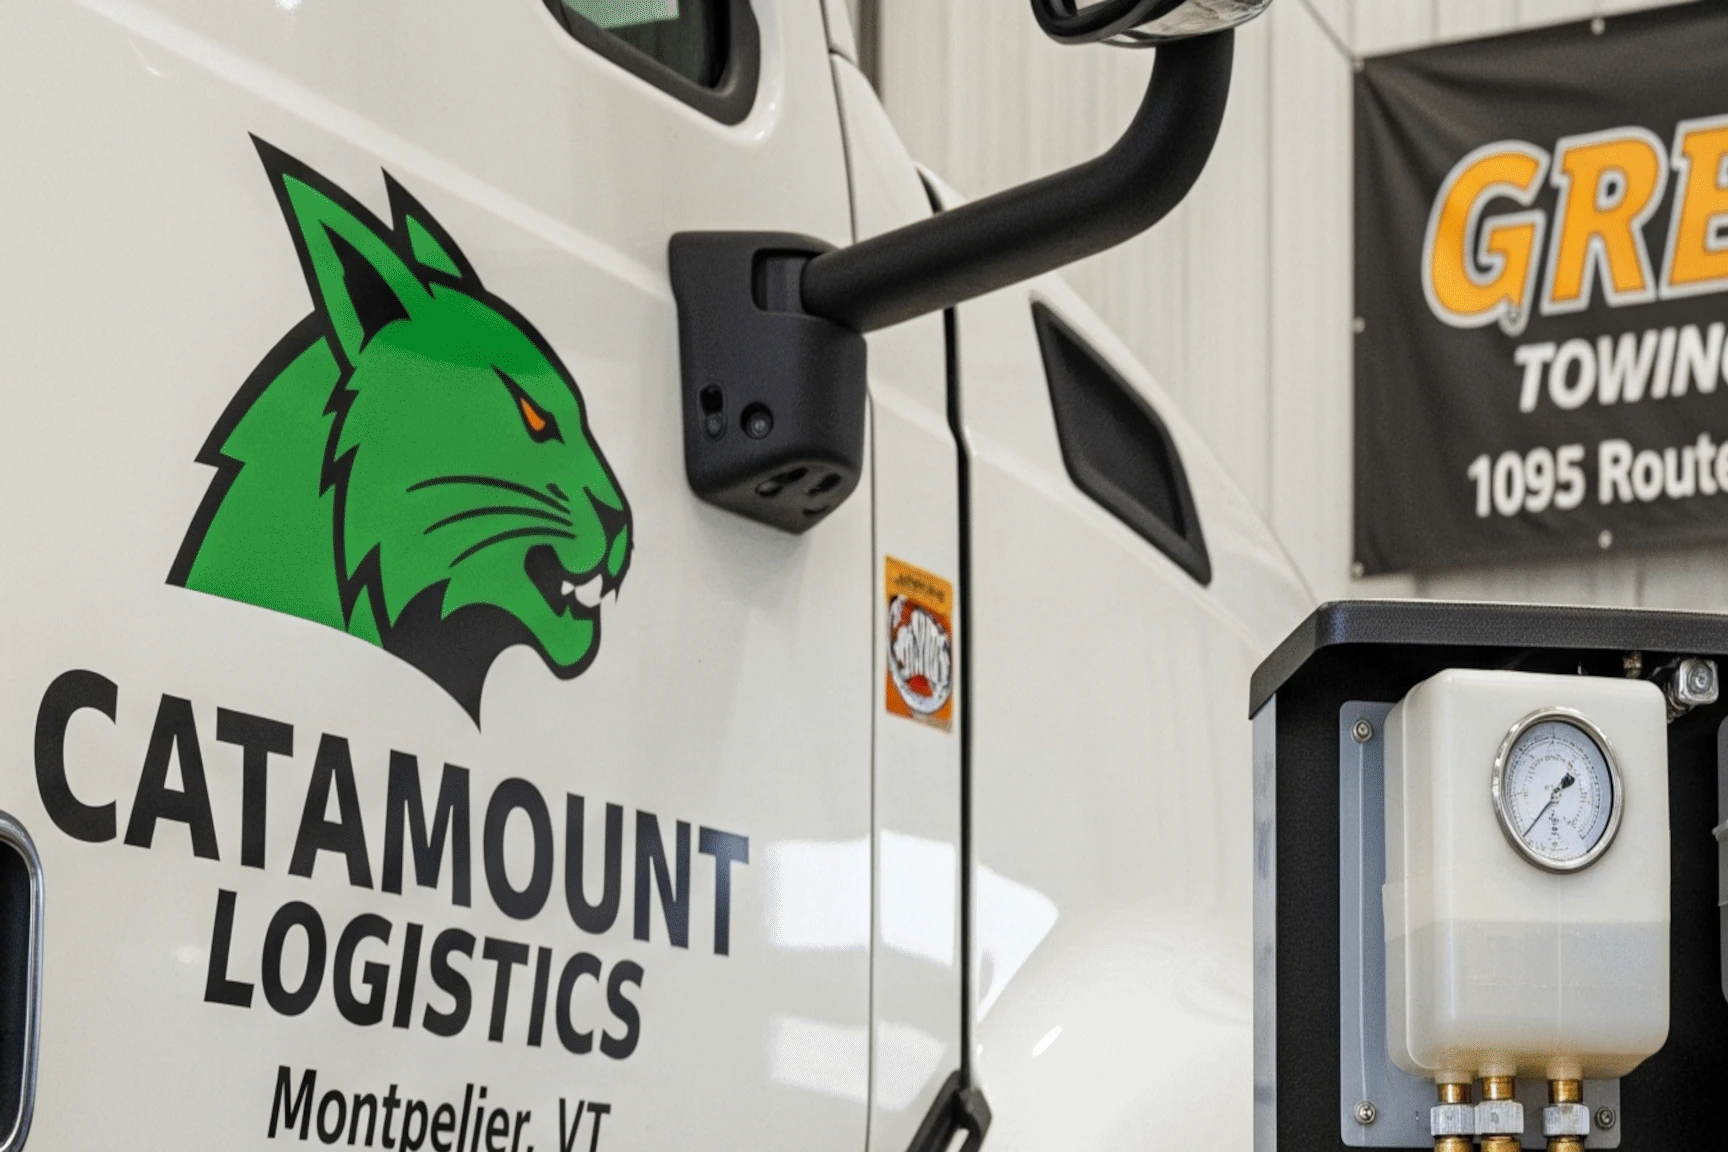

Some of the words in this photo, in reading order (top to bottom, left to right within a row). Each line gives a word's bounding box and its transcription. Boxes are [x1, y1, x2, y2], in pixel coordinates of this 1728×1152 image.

[1467, 445, 1585, 517] 1095
[33, 668, 750, 957] CATAMOUNT
[203, 888, 645, 1060] LOGISTICS
